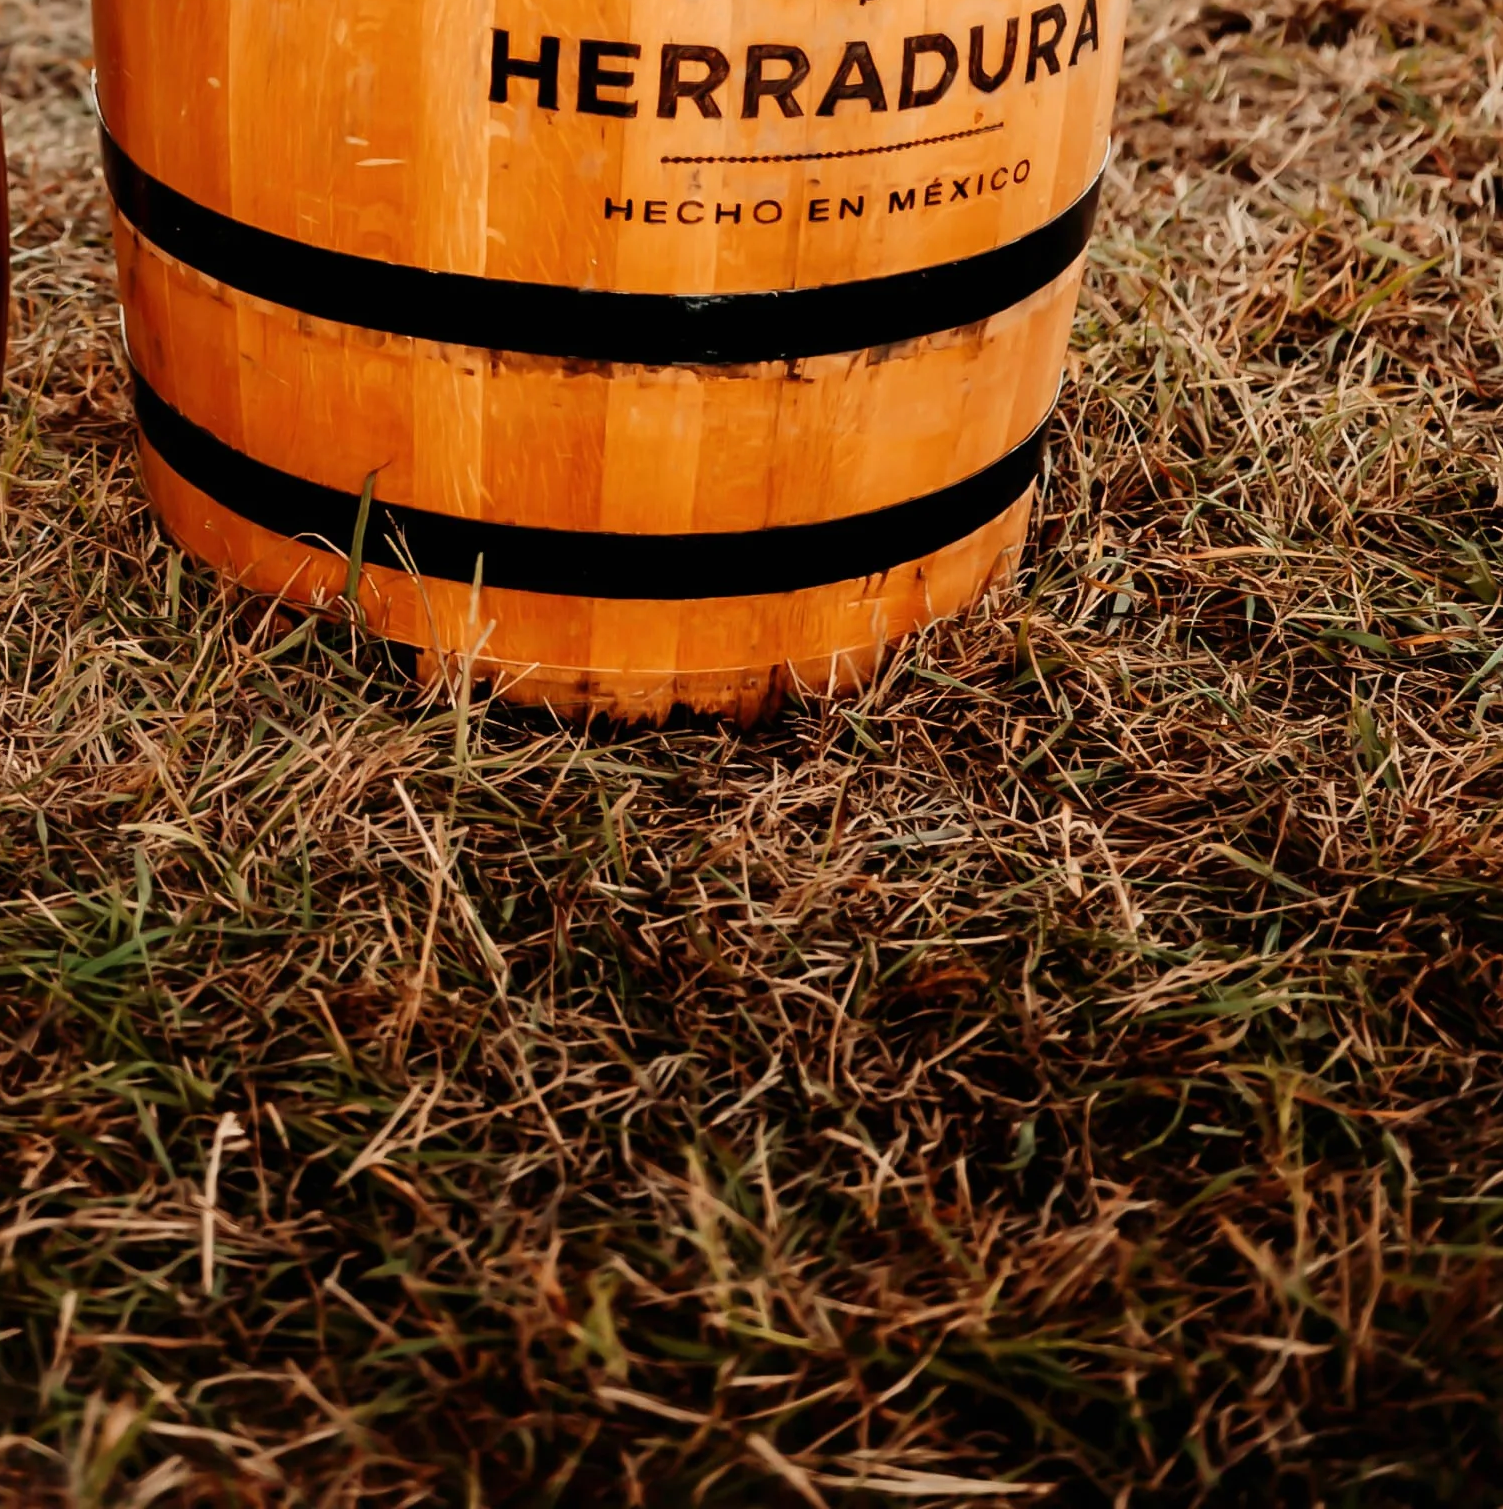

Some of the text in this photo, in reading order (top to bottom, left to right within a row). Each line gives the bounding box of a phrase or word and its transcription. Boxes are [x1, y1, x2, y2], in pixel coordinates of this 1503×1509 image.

[604, 159, 1030, 224] HECHO EN MÉXICO
